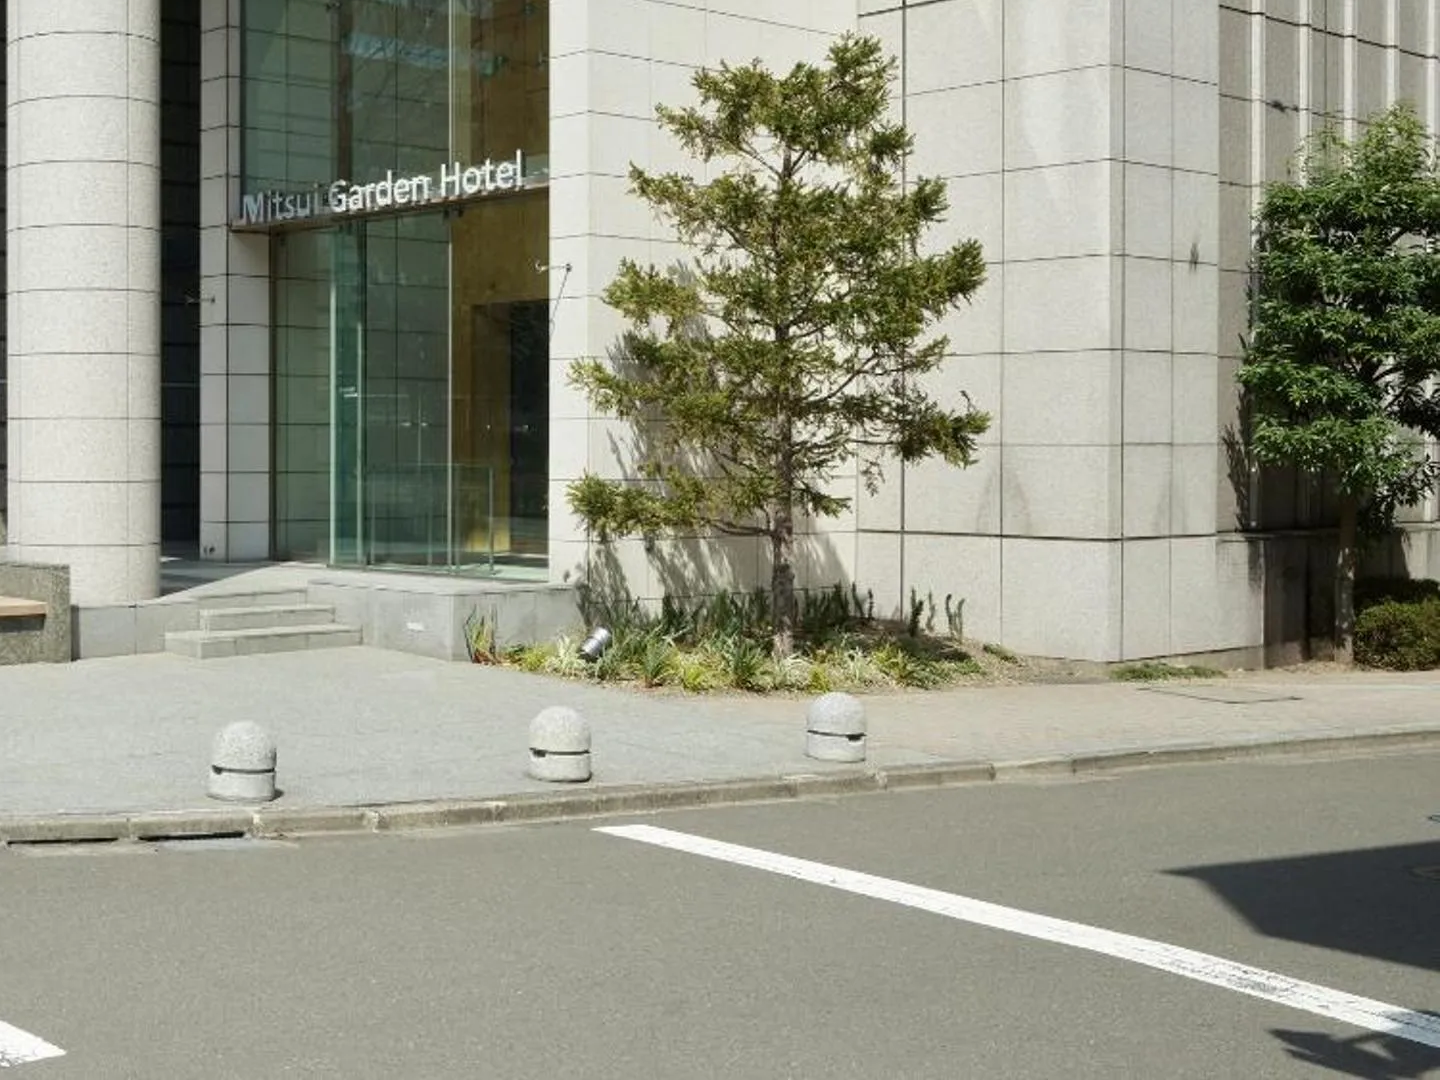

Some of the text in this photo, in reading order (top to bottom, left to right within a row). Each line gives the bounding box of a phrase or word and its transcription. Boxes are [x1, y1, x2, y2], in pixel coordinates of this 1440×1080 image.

[241, 148, 524, 224] Mitsui Garden Hotel
